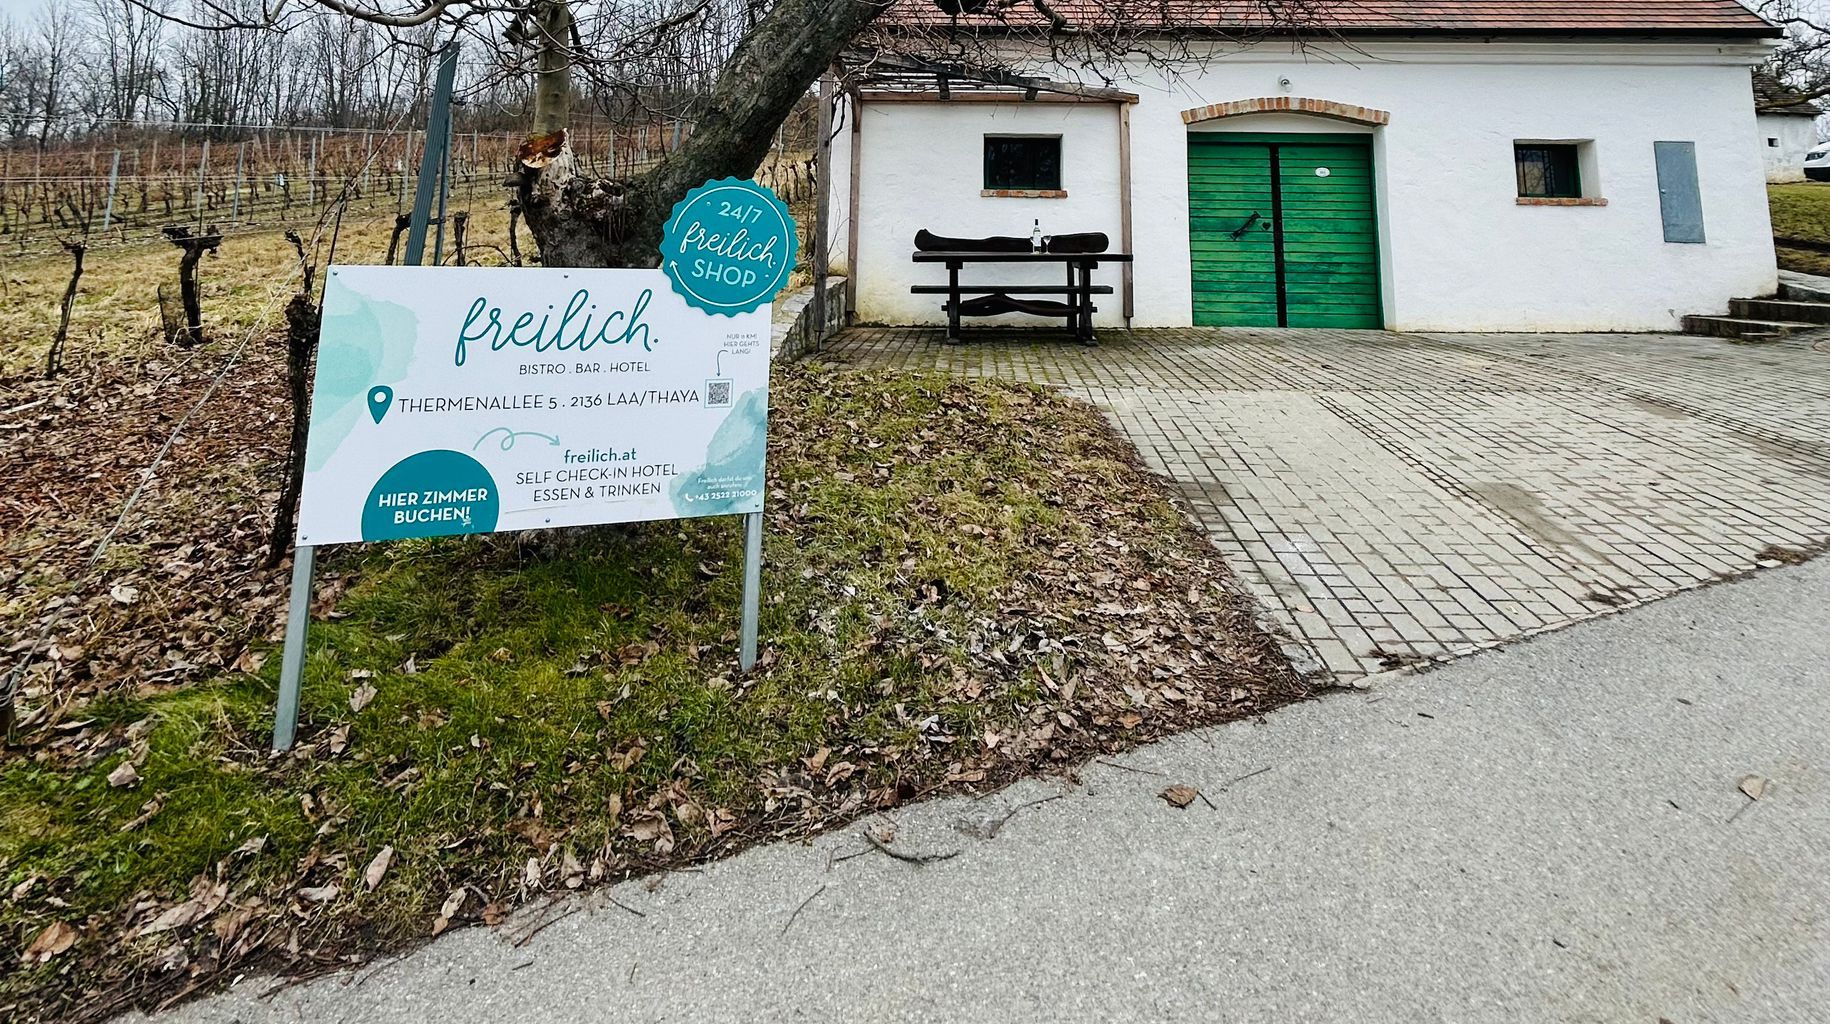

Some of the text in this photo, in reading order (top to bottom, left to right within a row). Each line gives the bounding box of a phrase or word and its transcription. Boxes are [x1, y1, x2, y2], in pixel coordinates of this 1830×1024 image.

[718, 201, 762, 224] 24/7
[691, 259, 757, 288] SHOP
[519, 363, 566, 375] BISTRO
[575, 363, 600, 374] BAR
[610, 361, 651, 373] HOTEL
[399, 394, 544, 413] THERMENALLEE
[548, 397, 558, 410] 5
[570, 394, 603, 409] 2136
[607, 389, 699, 407] LAA/THAYA
[564, 448, 637, 464] freilich.at
[516, 463, 678, 485] SELF CHECK-IN HOTEL
[379, 488, 488, 508] HIER ZIMMER
[533, 482, 661, 502] ESSEN & TRINKEN
[695, 490, 758, 501] +43 2522 21000
[394, 506, 470, 524] BUCHEN!
